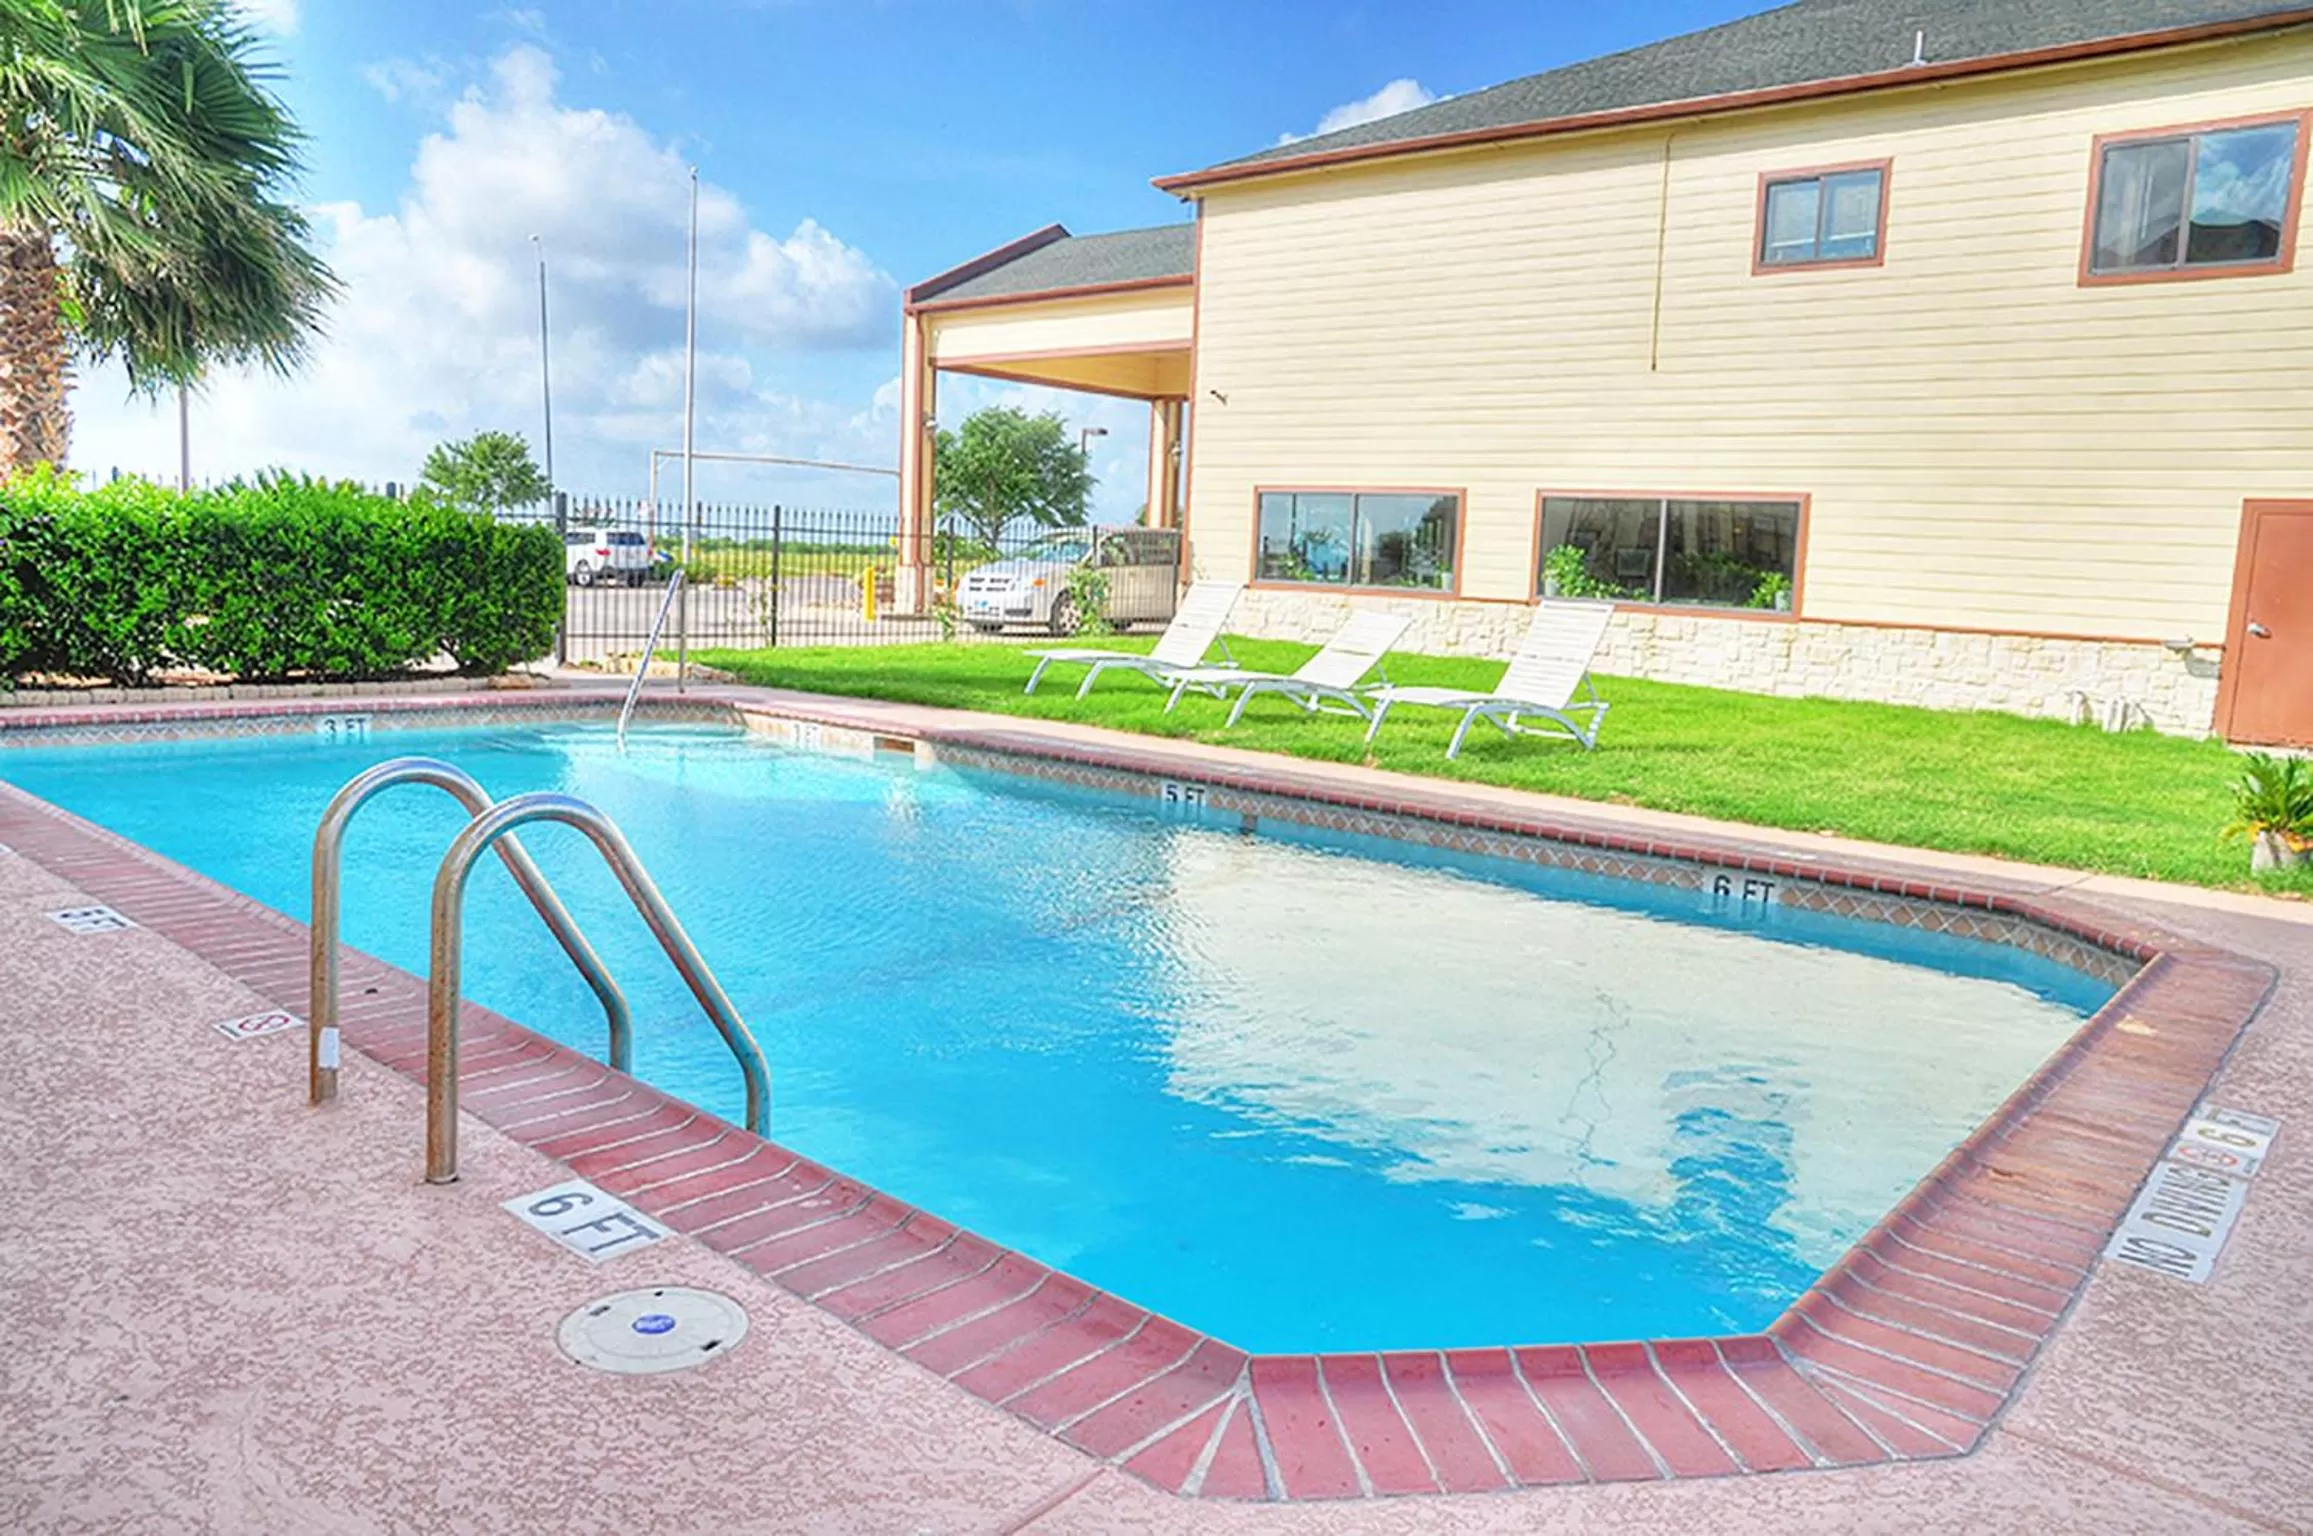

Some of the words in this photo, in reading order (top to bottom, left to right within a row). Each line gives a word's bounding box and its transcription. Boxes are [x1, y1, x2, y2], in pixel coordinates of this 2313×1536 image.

[1166, 784, 1177, 802] 5
[1185, 786, 1205, 805] FT
[1742, 879, 1775, 904] FT
[2197, 1127, 2257, 1148] 6
[2140, 1166, 2231, 1238] DIVING
[528, 1192, 594, 1217] 6
[561, 1212, 661, 1252] FT
[2117, 1237, 2197, 1278] NO
